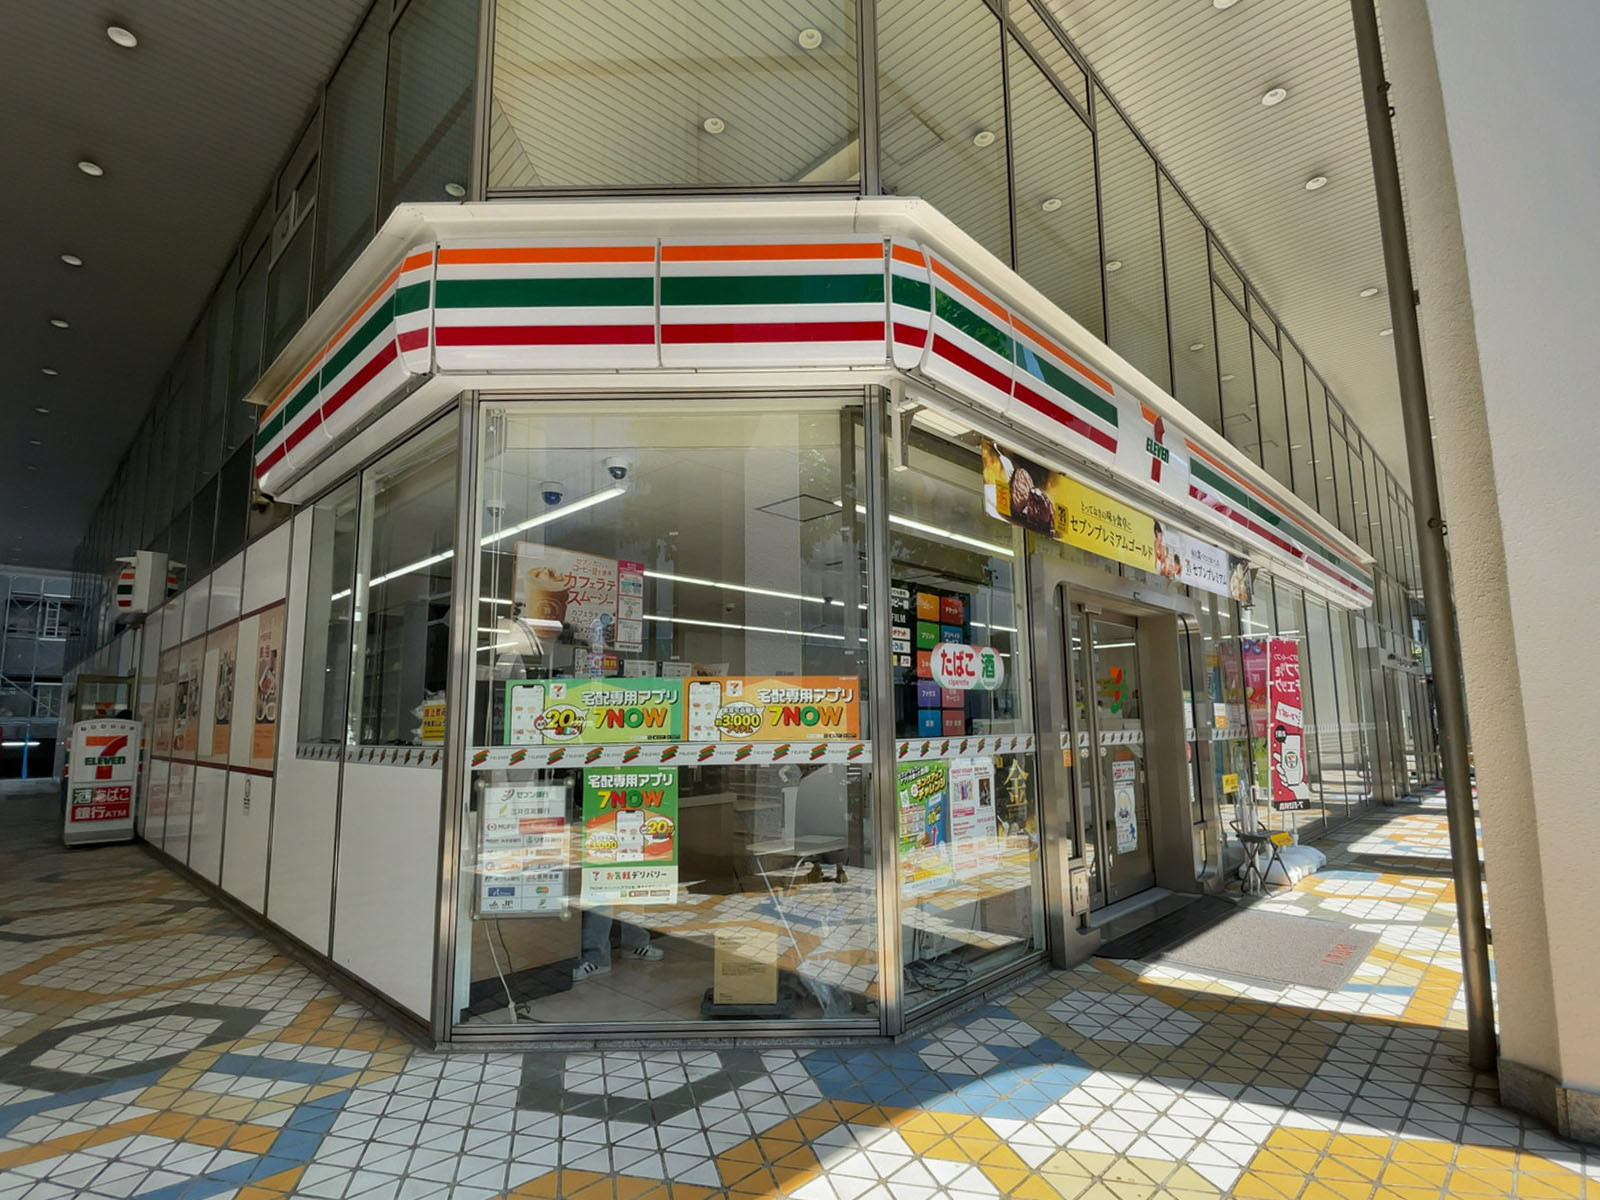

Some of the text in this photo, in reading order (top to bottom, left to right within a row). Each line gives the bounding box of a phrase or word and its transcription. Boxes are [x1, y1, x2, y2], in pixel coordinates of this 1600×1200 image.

[1070, 515, 1153, 560] セブンプレミアムゴールド
[563, 572, 616, 592] カフェラテ
[1192, 563, 1227, 584] セブンプレミアム
[566, 590, 614, 606] スムージー
[940, 649, 976, 678] たばこ
[980, 653, 995, 679] 酒
[581, 688, 680, 706] 宅配専用アプリ
[757, 687, 854, 704] 宅配専用アプリ
[593, 707, 669, 729] 7NOW
[768, 705, 844, 727] 7NOW
[588, 772, 674, 789] 宅配専用アプリ
[73, 787, 130, 804] 酒 たばこ
[516, 790, 550, 799] セブン銀行
[597, 789, 665, 809] 7NOW
[606, 870, 668, 881] お気軽デリバリー
